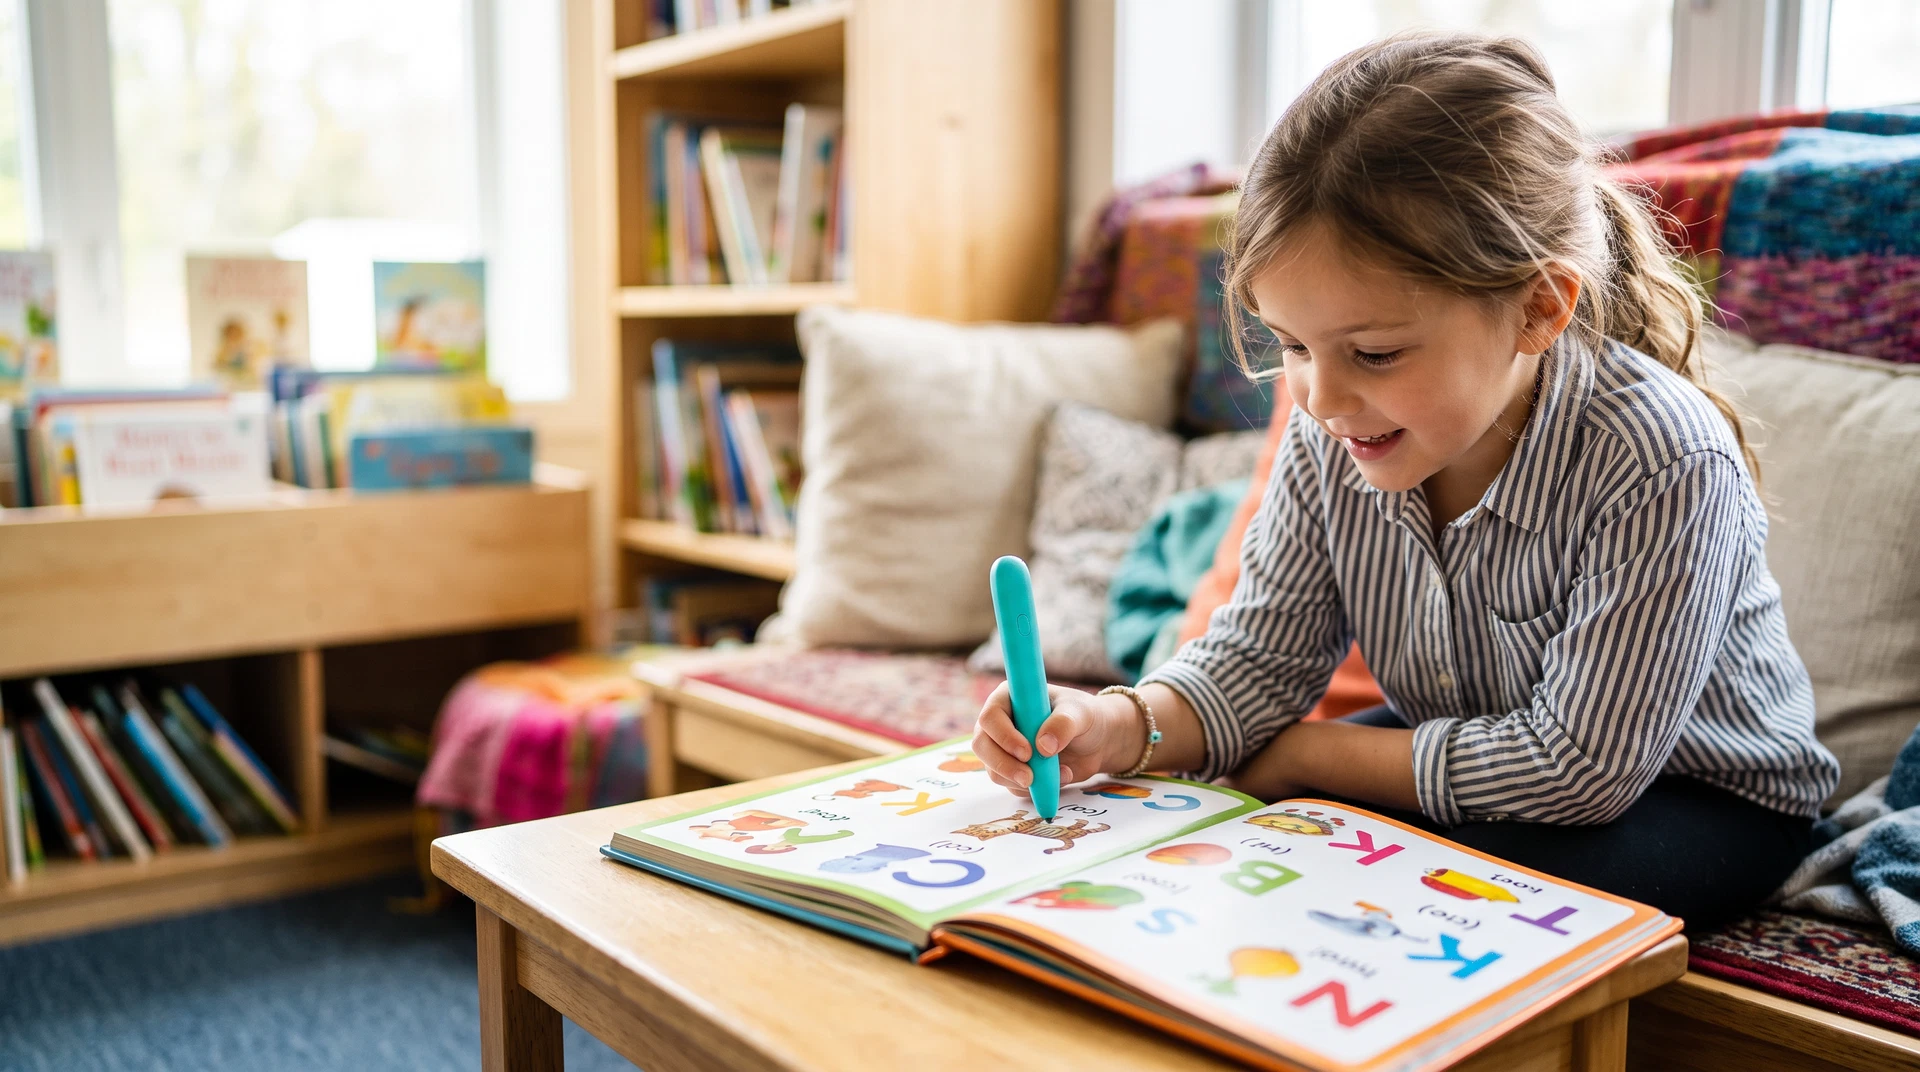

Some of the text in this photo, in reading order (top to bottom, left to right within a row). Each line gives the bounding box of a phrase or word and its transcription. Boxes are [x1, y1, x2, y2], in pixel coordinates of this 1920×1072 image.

[881, 791, 954, 817] K
[1142, 794, 1202, 812] C
[1328, 830, 1405, 866] K
[892, 859, 985, 888] C
[1219, 860, 1303, 896] B
[1134, 908, 1198, 935] S
[1509, 906, 1579, 936] T
[1405, 932, 1504, 980] K
[1288, 980, 1394, 1028] N
